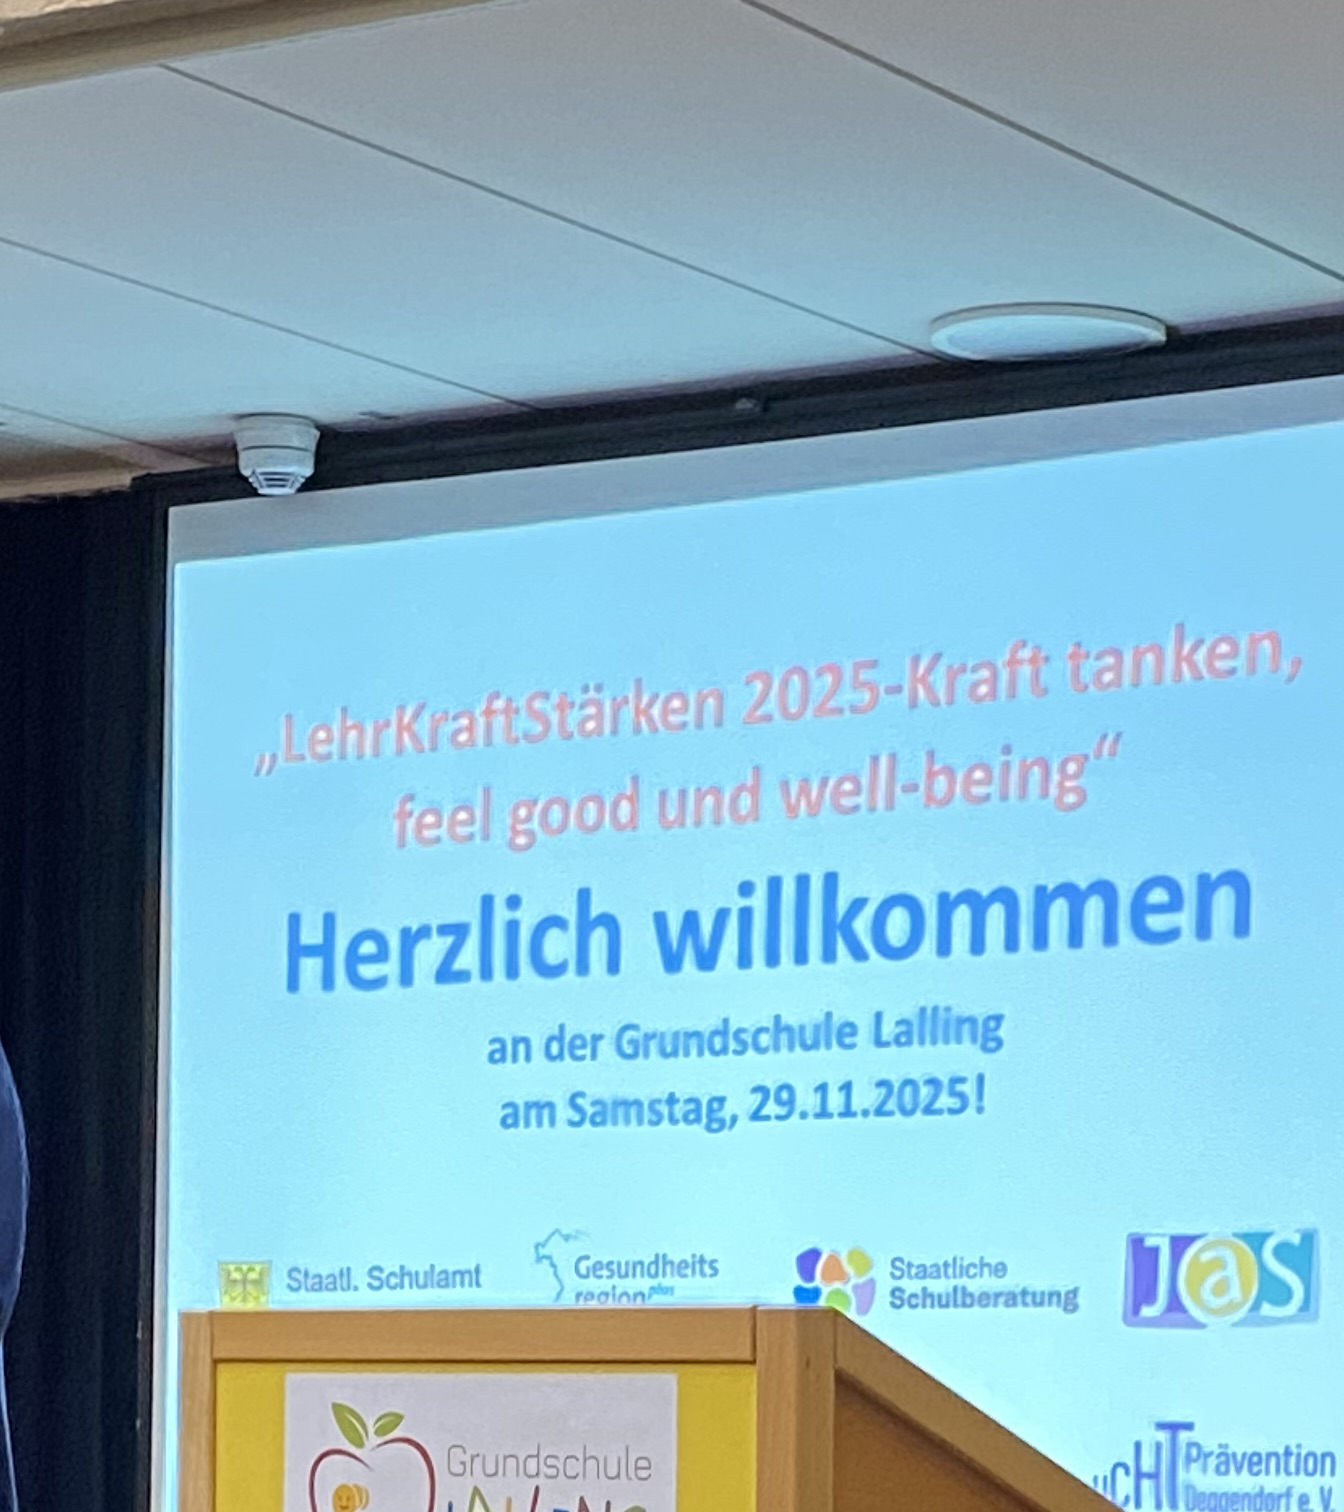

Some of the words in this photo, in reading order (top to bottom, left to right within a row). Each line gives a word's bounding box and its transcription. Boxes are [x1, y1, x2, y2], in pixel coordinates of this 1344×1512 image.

[743, 639, 1051, 725] 2025-Kraft
[1066, 622, 1302, 693] tanken,
[394, 785, 492, 850] feel
[508, 774, 639, 852] good
[658, 765, 762, 830] und
[286, 887, 621, 994] Herzlich
[653, 869, 1251, 974] willkommen
[488, 1036, 532, 1065] an
[544, 1023, 605, 1062] der
[614, 1010, 858, 1060] Grundschule
[873, 1005, 1005, 1054] Lalling
[500, 1100, 556, 1130] am
[567, 1091, 738, 1134] Samstag,
[749, 1072, 985, 1122] 29.11.2025!
[286, 1266, 359, 1292] Staatl.
[367, 1263, 482, 1292] Schulamt
[574, 1253, 720, 1280] Gesundheits
[889, 1255, 1008, 1280] Staatliche
[889, 1285, 1080, 1315] Schulberatung
[446, 1443, 653, 1482] Grundschule
[1183, 1441, 1336, 1477] Prävention
